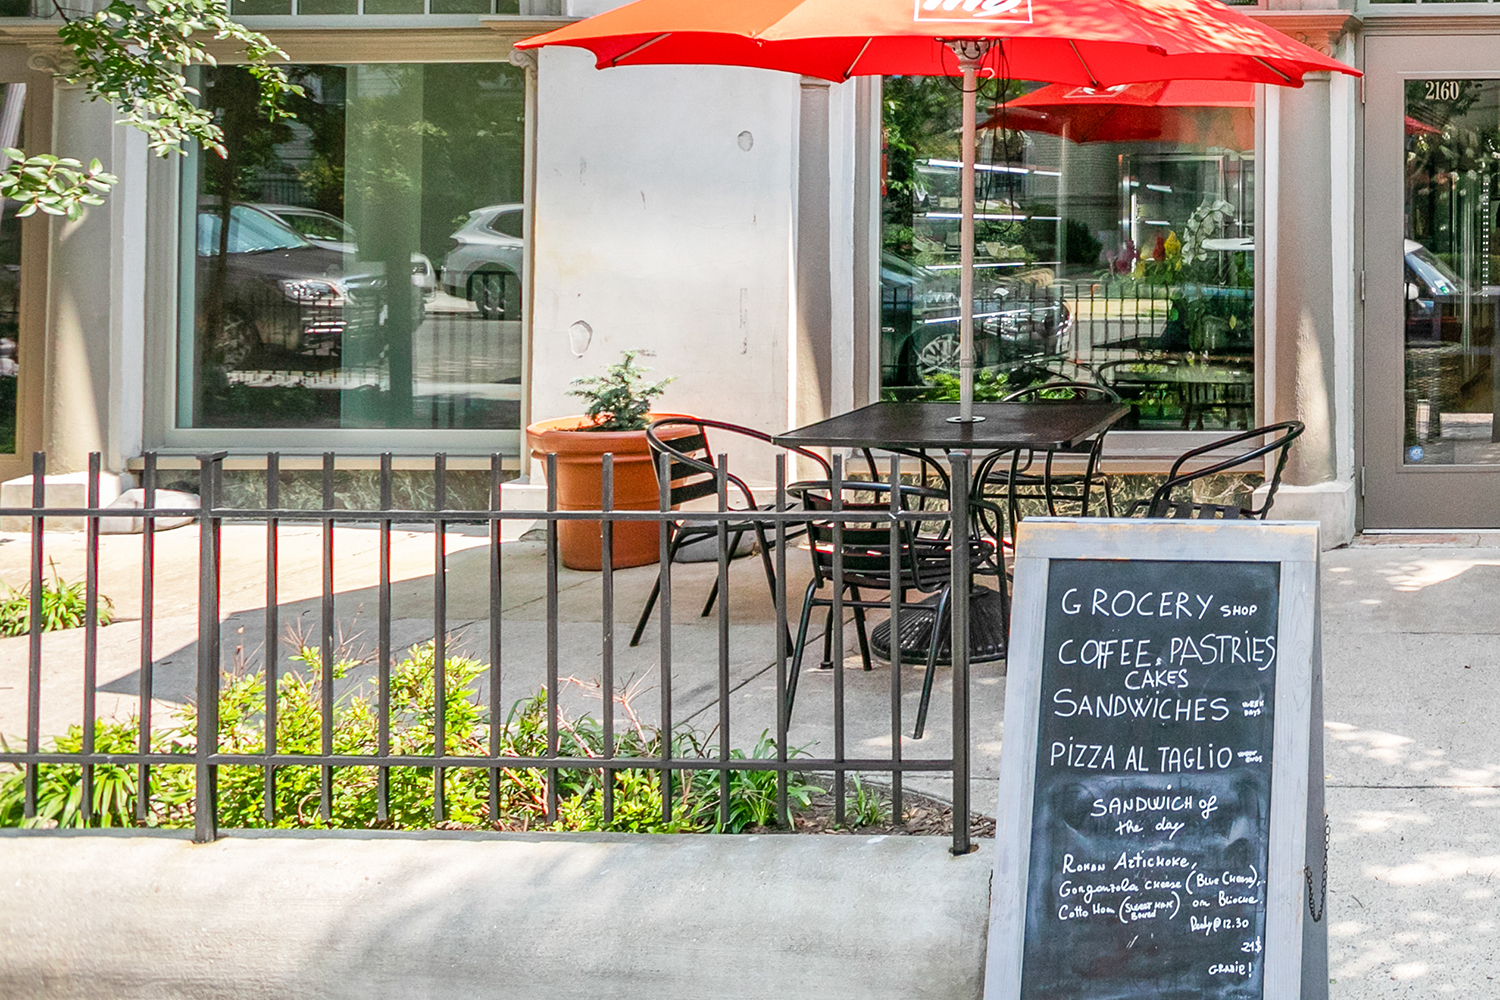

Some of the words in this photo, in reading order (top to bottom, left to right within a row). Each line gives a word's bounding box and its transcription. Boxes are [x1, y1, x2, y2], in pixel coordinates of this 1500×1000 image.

[1425, 80, 1460, 101] 2160
[1061, 588, 1214, 619] GROCERY
[1220, 605, 1257, 617] SHOP
[1058, 638, 1151, 669] COFFEE
[1170, 630, 1275, 671] PASTRIES
[1125, 668, 1189, 690] CAKES
[1053, 688, 1230, 722] SANDWICHES
[1050, 736, 1115, 769] PIZZA
[1125, 746, 1149, 772] AL
[1158, 743, 1233, 772] TAGLIO
[1090, 795, 1193, 817] SANDWICH
[1199, 795, 1218, 819] of
[1115, 820, 1143, 835] the
[1155, 816, 1185, 840] day
[1058, 904, 1089, 920] Cotto
